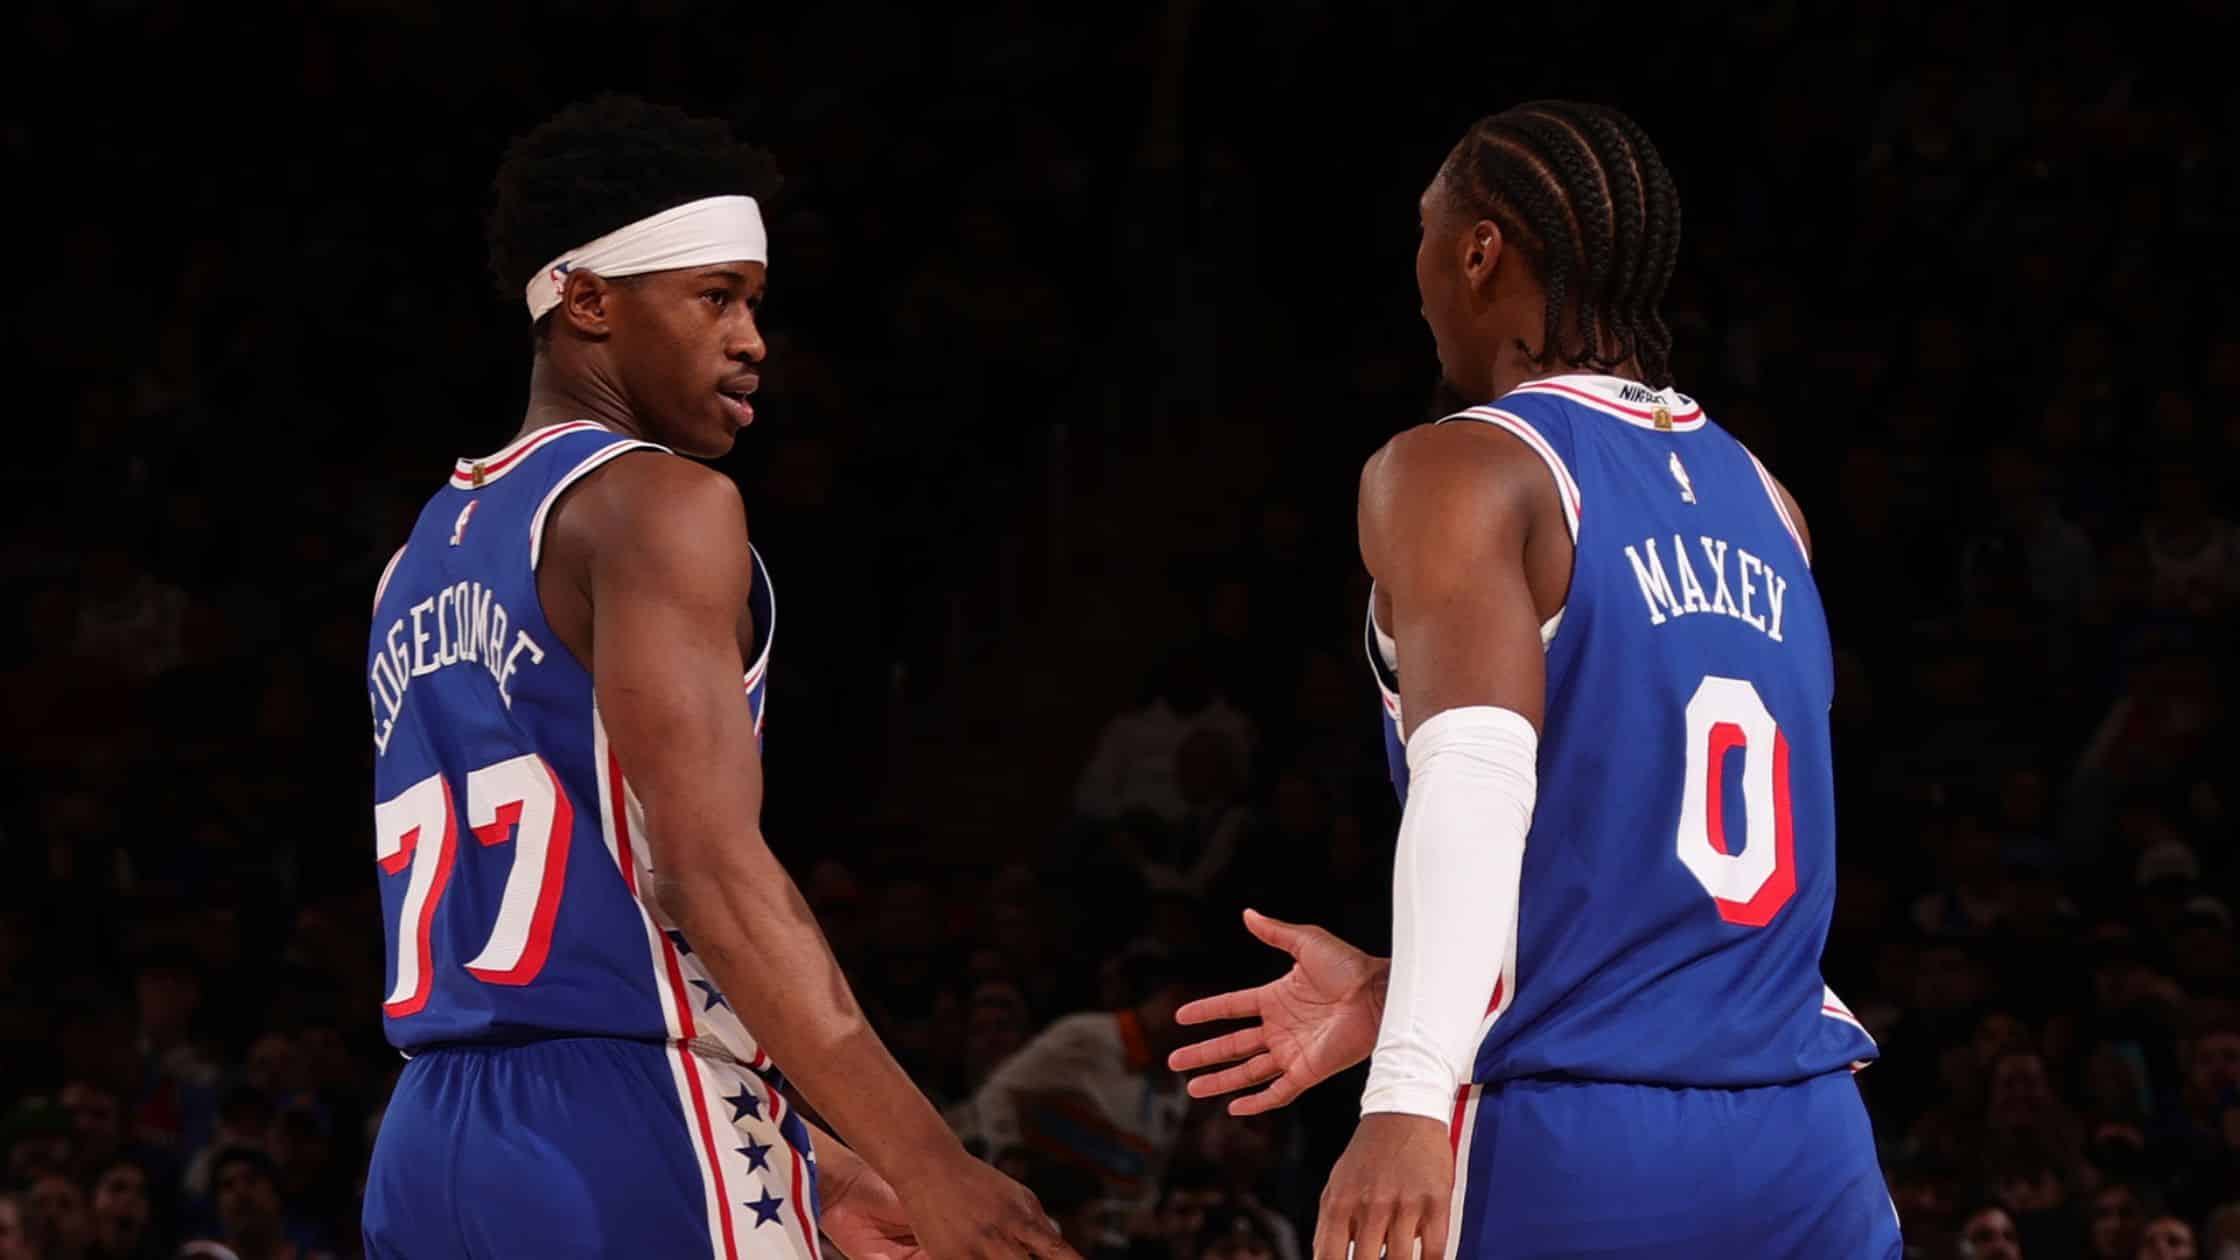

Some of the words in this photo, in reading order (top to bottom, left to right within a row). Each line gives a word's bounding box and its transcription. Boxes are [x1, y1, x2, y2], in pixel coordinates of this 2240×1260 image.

[1625, 534, 1787, 642] MAXEY
[374, 752, 575, 1019] 77
[1676, 675, 1797, 927] 0
